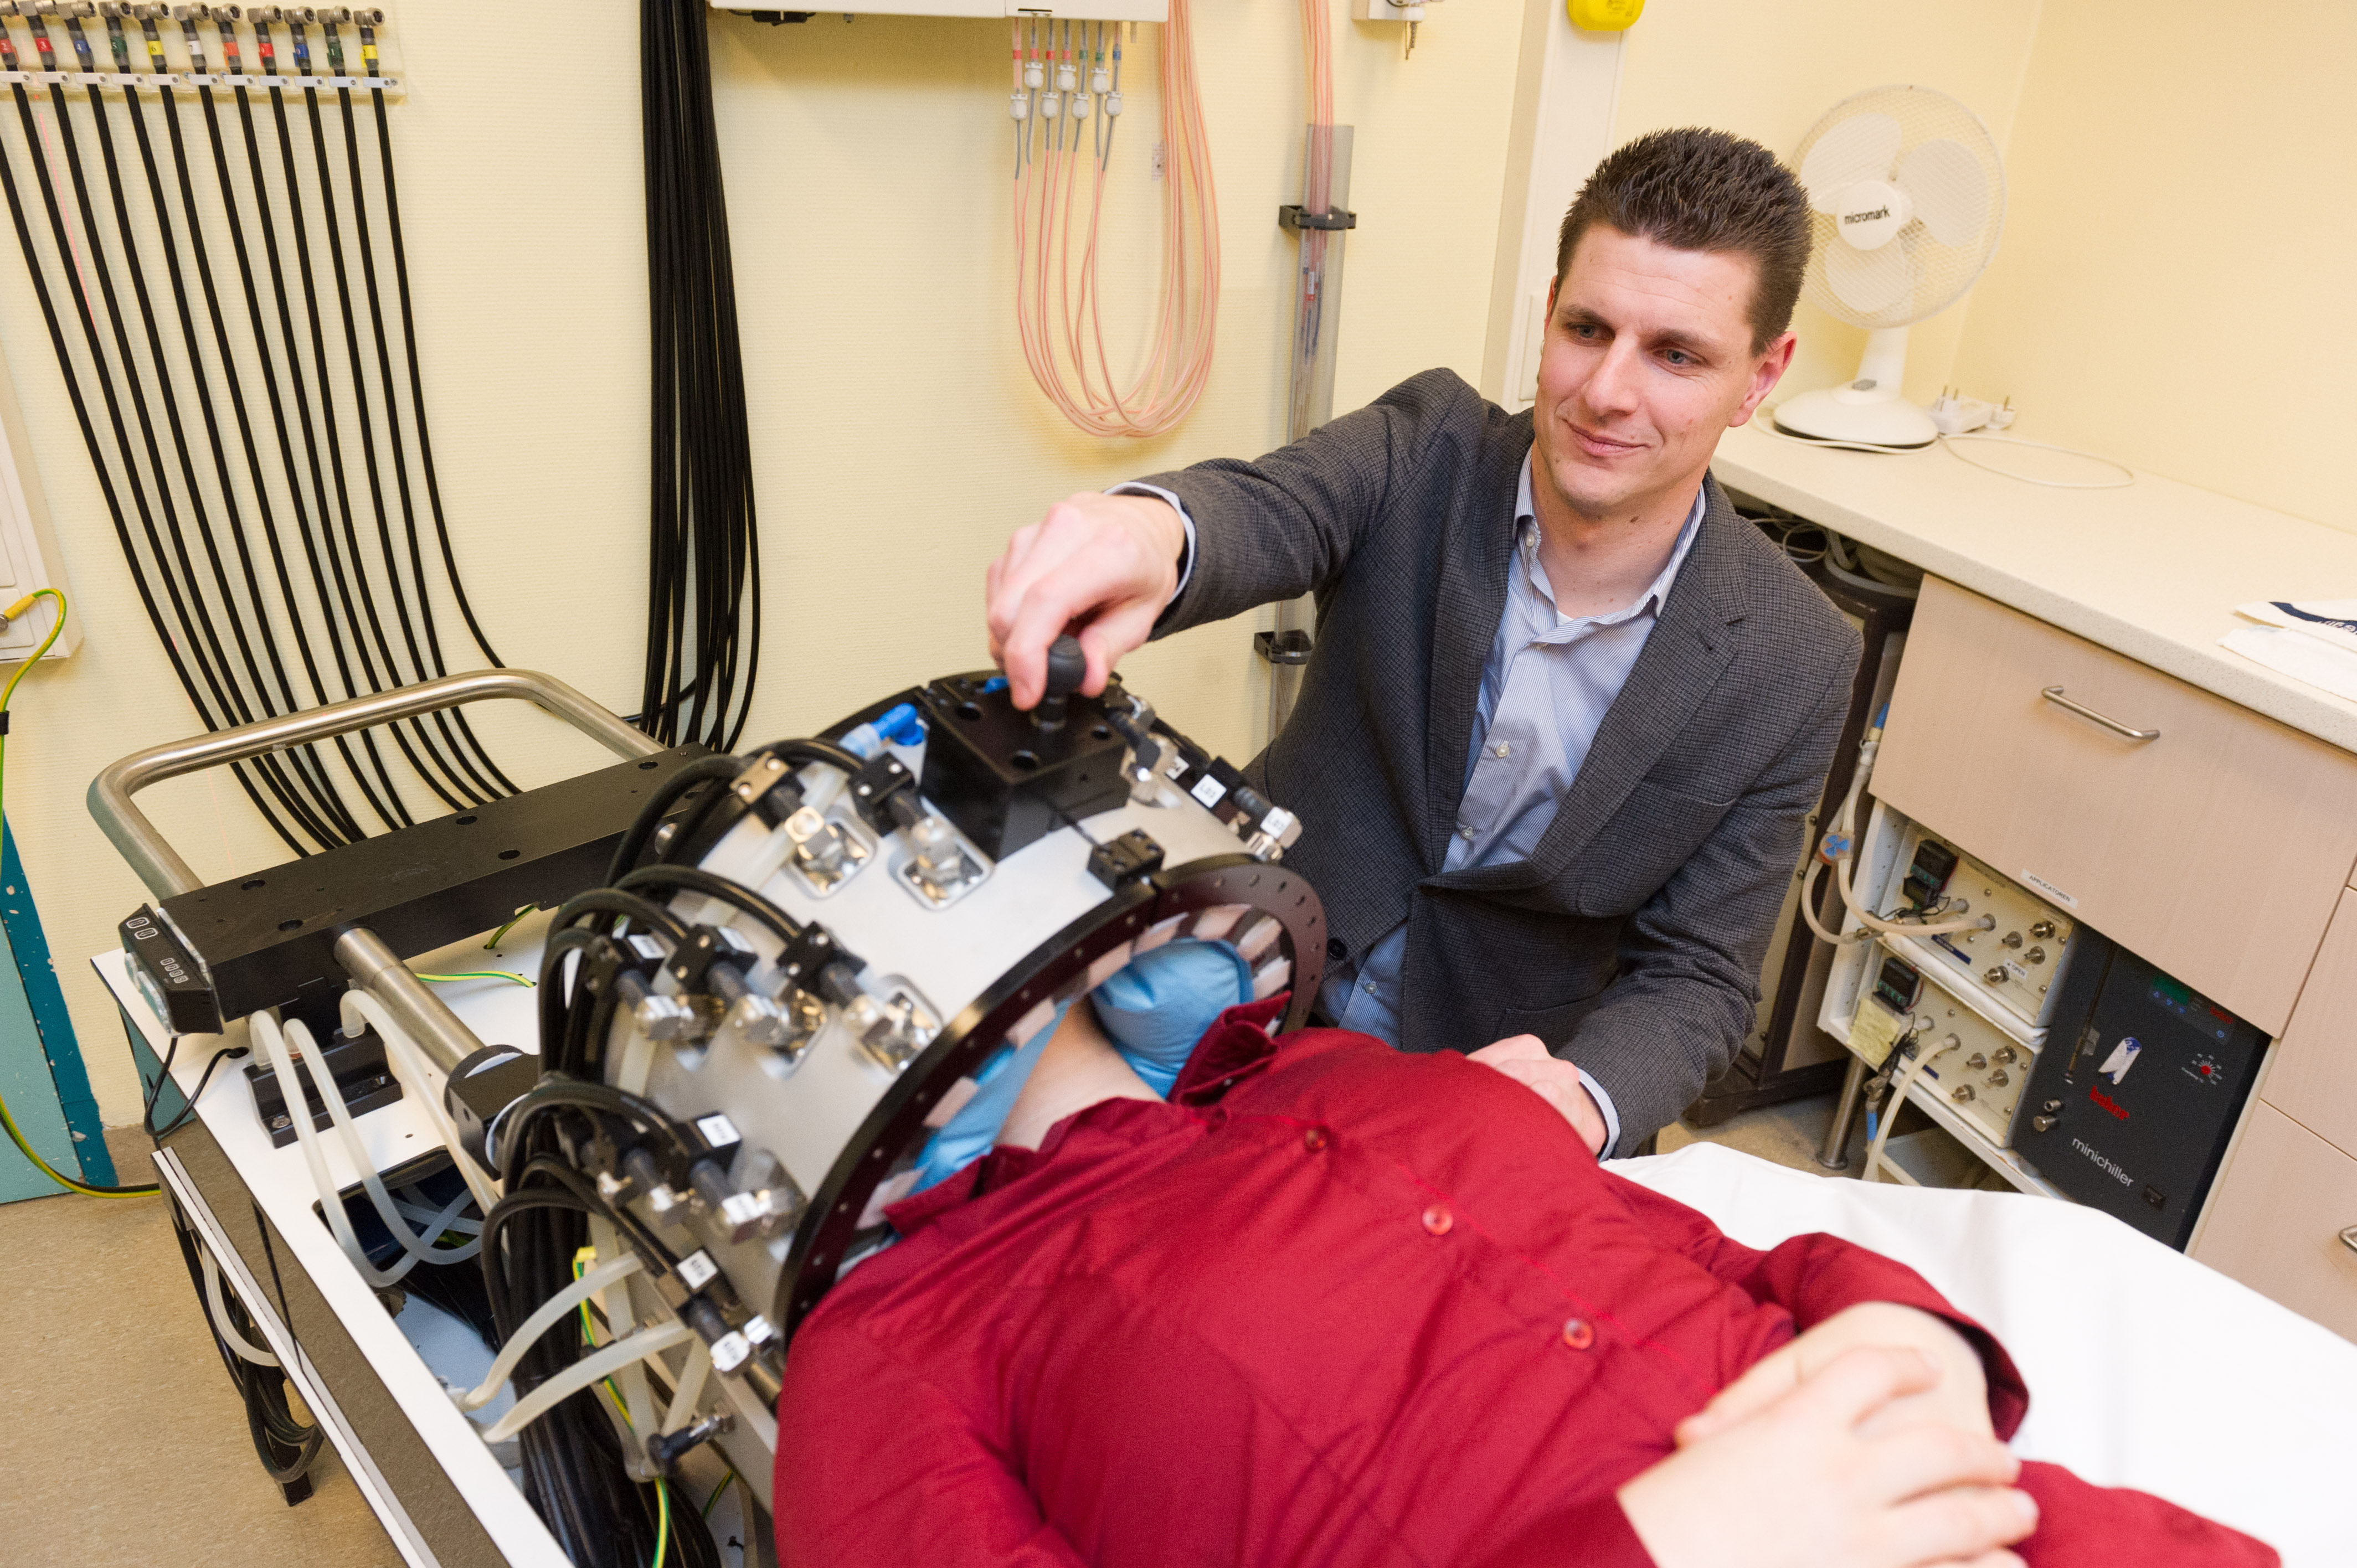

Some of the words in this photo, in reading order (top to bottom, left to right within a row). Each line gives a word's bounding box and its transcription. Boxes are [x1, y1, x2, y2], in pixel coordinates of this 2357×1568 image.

[40, 41, 47, 49] 3
[76, 43, 82, 51] 4
[1844, 204, 1890, 225] micromark
[2029, 875, 2071, 902] APPLICATOREN
[2090, 1085, 2129, 1121] huber
[2071, 1138, 2134, 1187] minichiller
